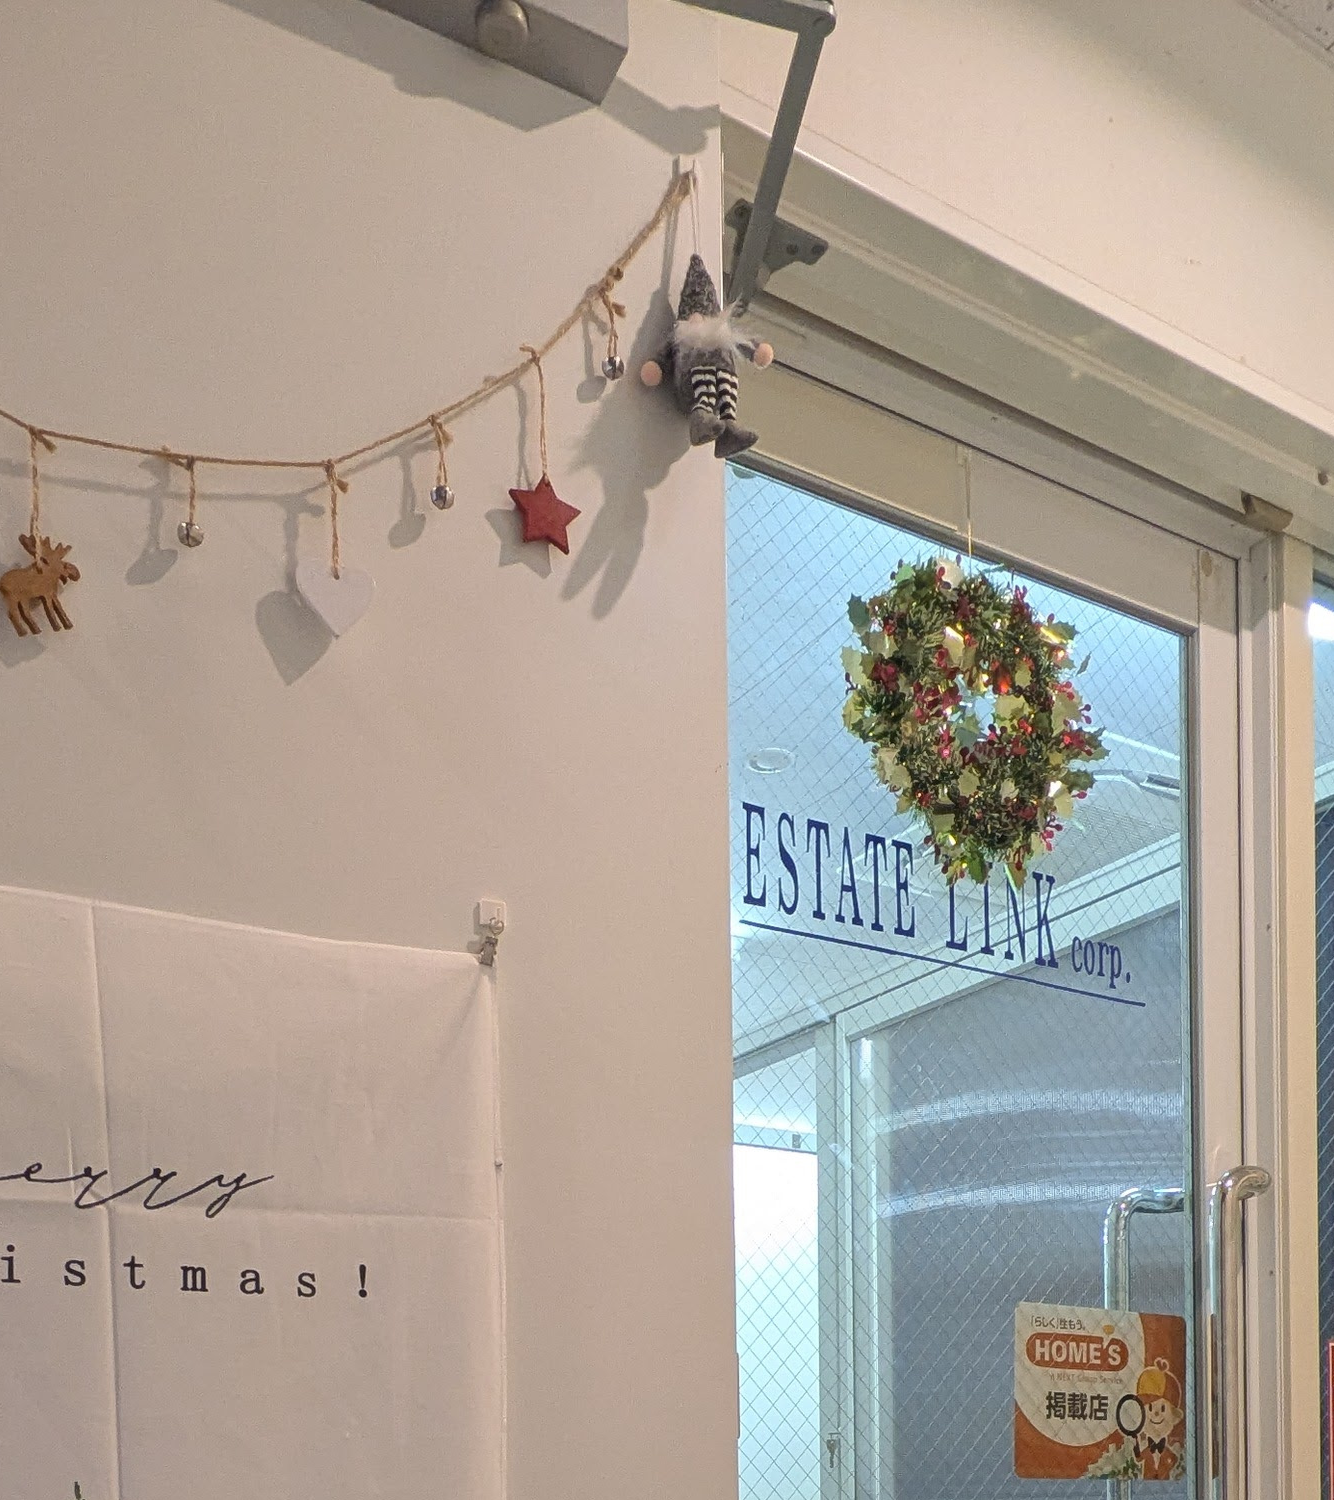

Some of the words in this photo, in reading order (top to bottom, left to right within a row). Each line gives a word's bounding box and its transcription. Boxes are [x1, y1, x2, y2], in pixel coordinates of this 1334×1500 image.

[741, 801, 916, 938] ESTATE
[945, 863, 1059, 969] LINK
[1070, 936, 1132, 990] corp.
[1034, 1337, 1122, 1366] HOME'S
[1045, 1390, 1109, 1421] 掲載店
